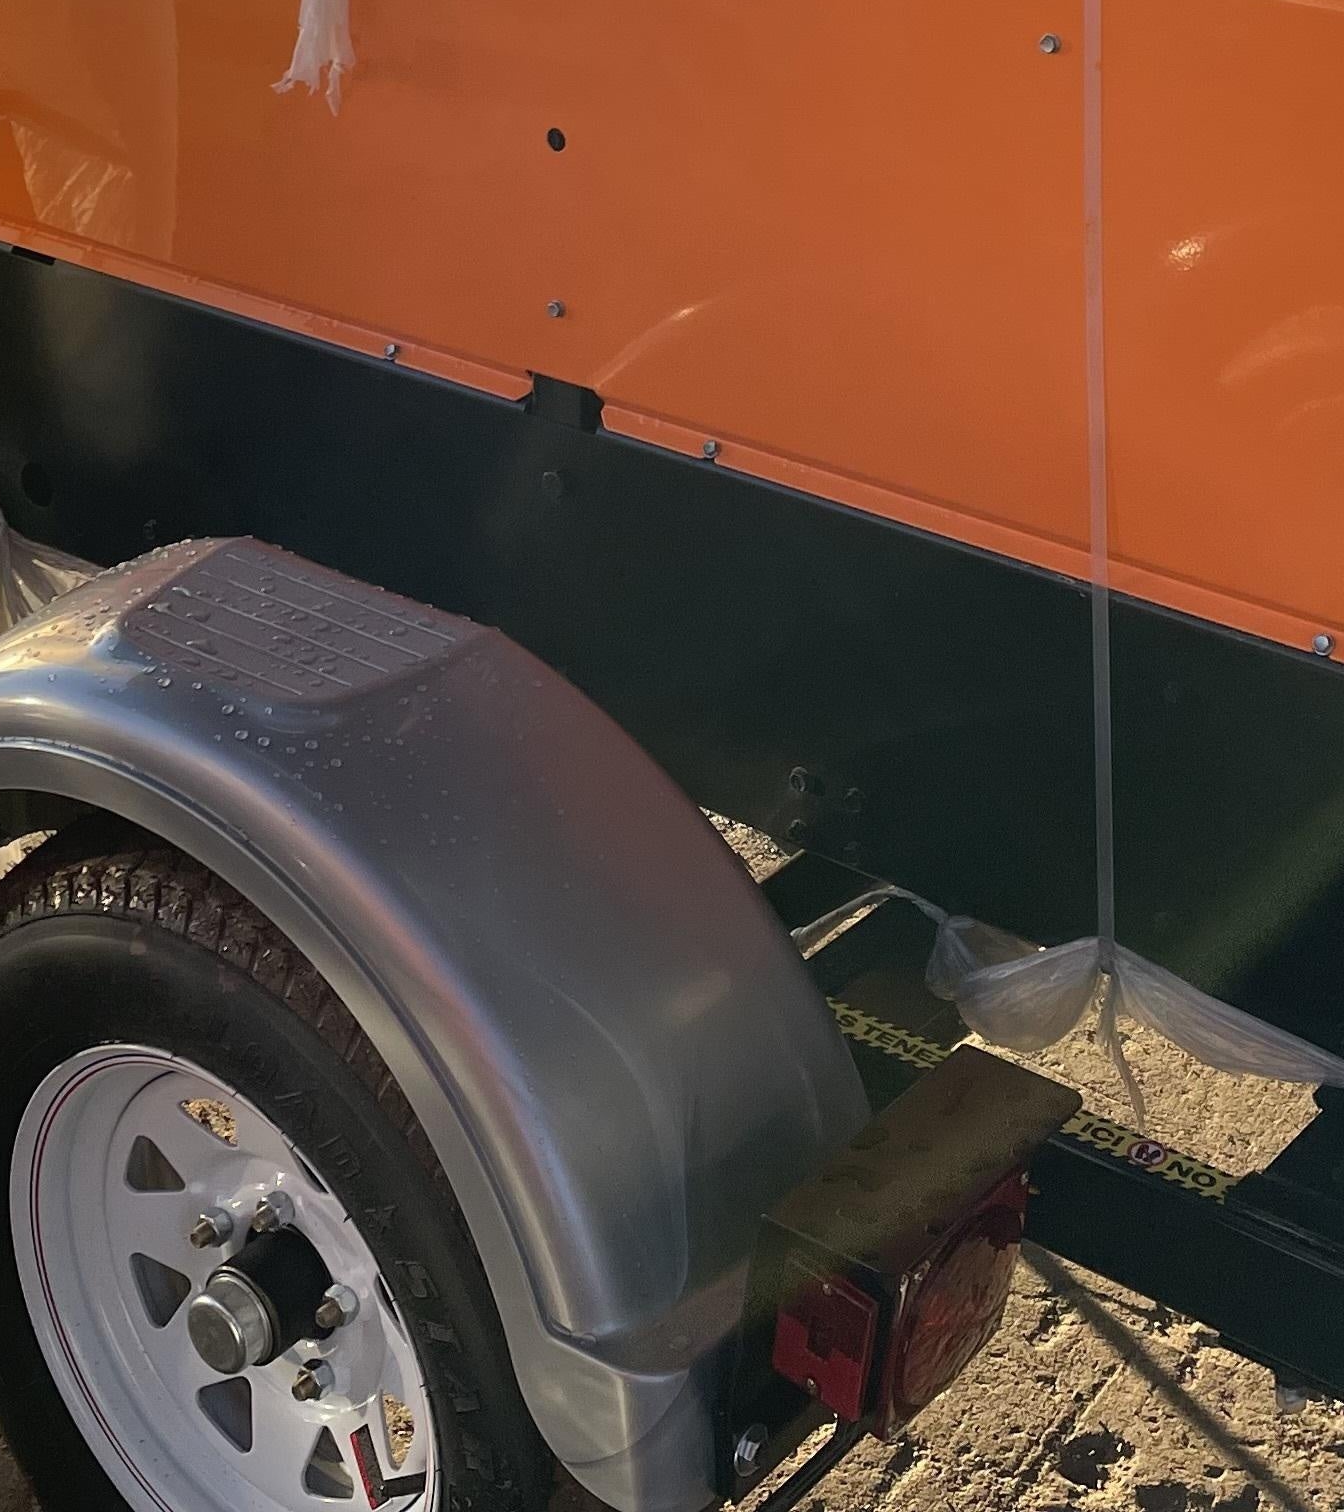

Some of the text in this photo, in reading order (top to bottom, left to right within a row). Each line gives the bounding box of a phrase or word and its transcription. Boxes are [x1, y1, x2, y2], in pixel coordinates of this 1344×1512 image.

[863, 1023, 935, 1061] TENE
[1080, 1122, 1217, 1187] ICI NO
